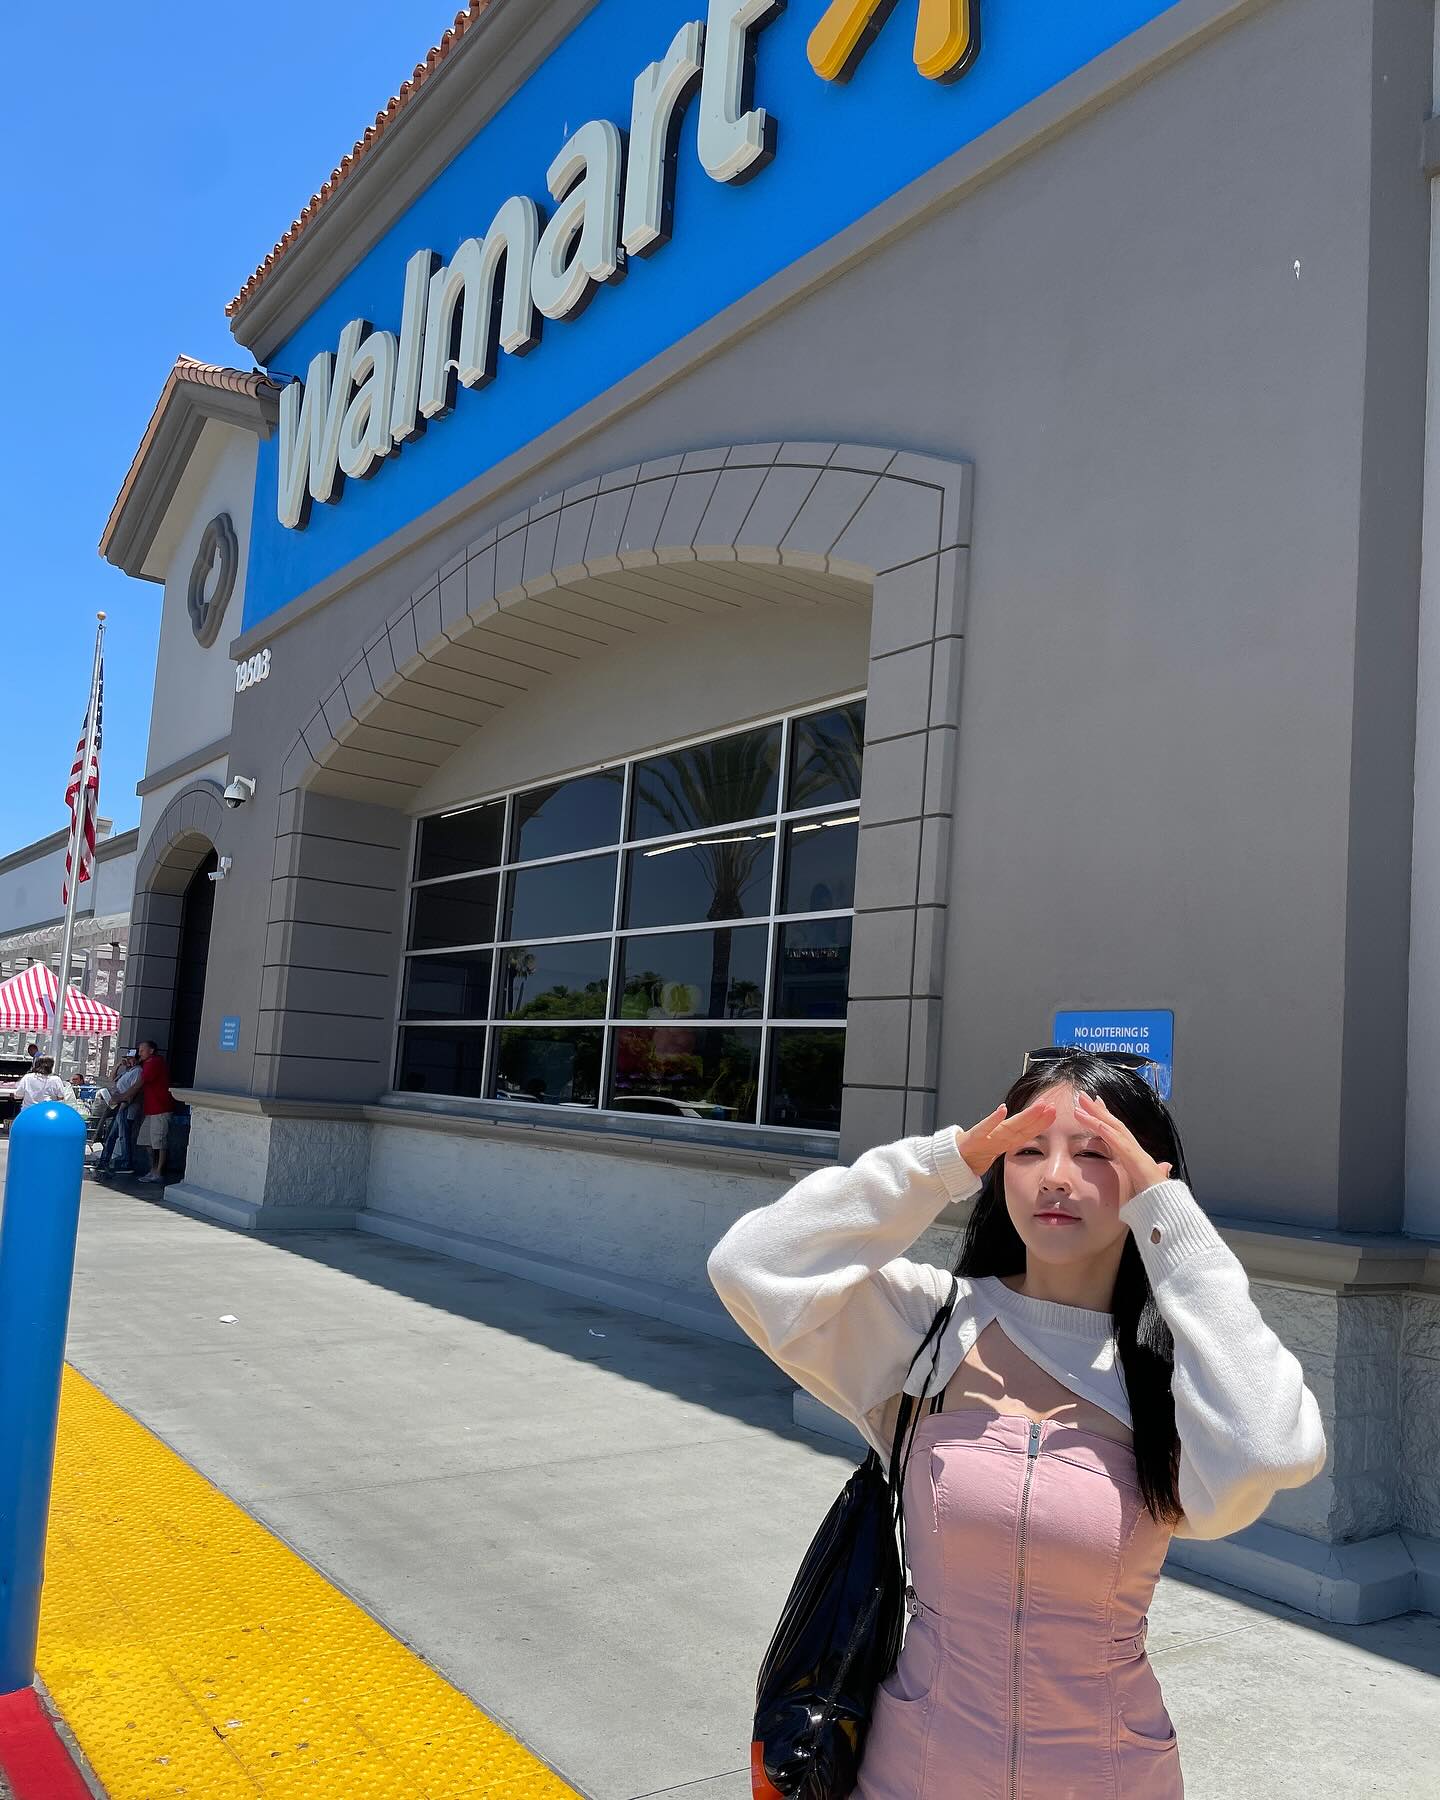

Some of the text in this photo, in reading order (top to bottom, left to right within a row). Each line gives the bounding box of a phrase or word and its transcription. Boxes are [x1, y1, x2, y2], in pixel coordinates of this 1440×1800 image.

[278, 0, 788, 530] Walmart
[1074, 1027, 1149, 1038] NO LOITERING IS
[1075, 1042, 1150, 1053] LOWED ON OR
